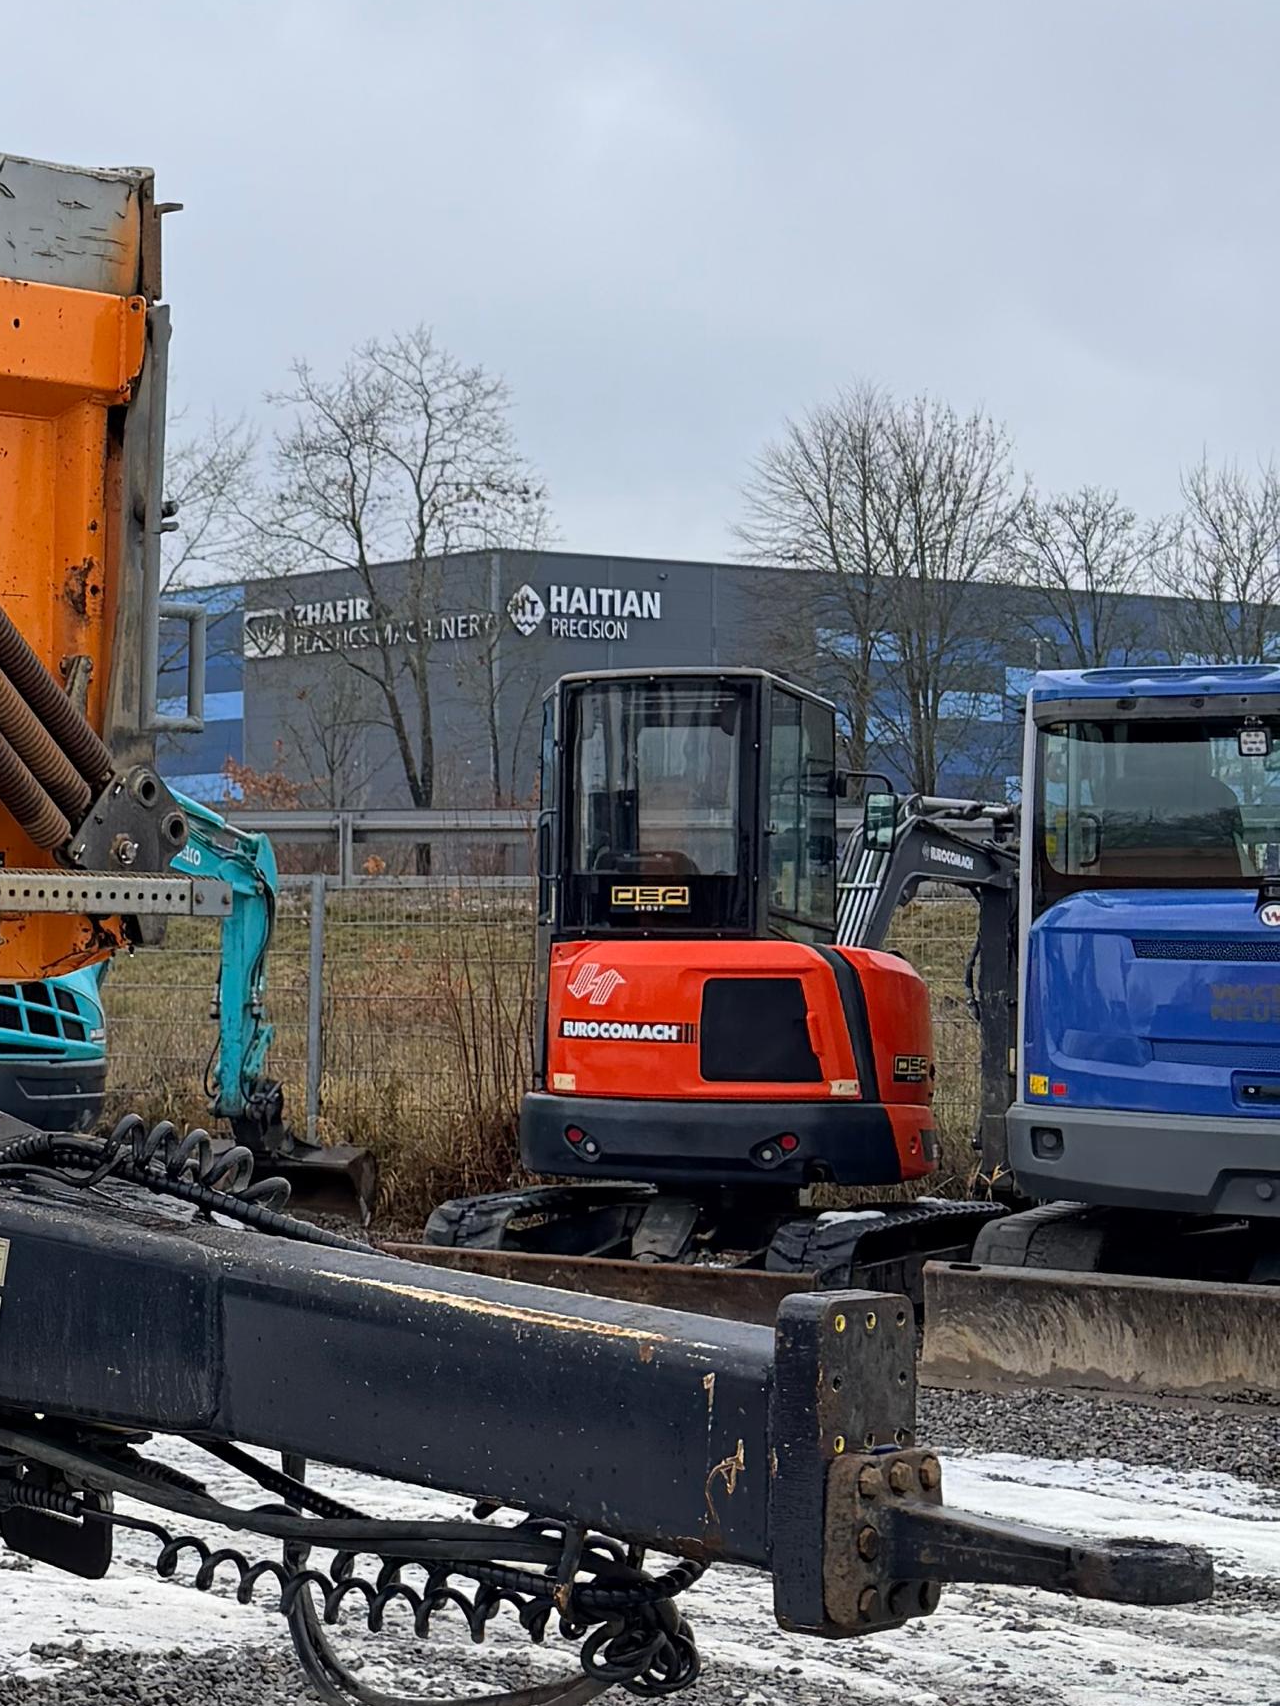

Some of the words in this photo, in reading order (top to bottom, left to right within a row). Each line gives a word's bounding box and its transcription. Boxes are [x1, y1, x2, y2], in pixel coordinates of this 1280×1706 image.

[294, 598, 372, 626] ZHAFIR
[549, 585, 660, 619] HAITIAN
[551, 618, 628, 639] PRECISION
[563, 1021, 678, 1041] EUROCOMACH
